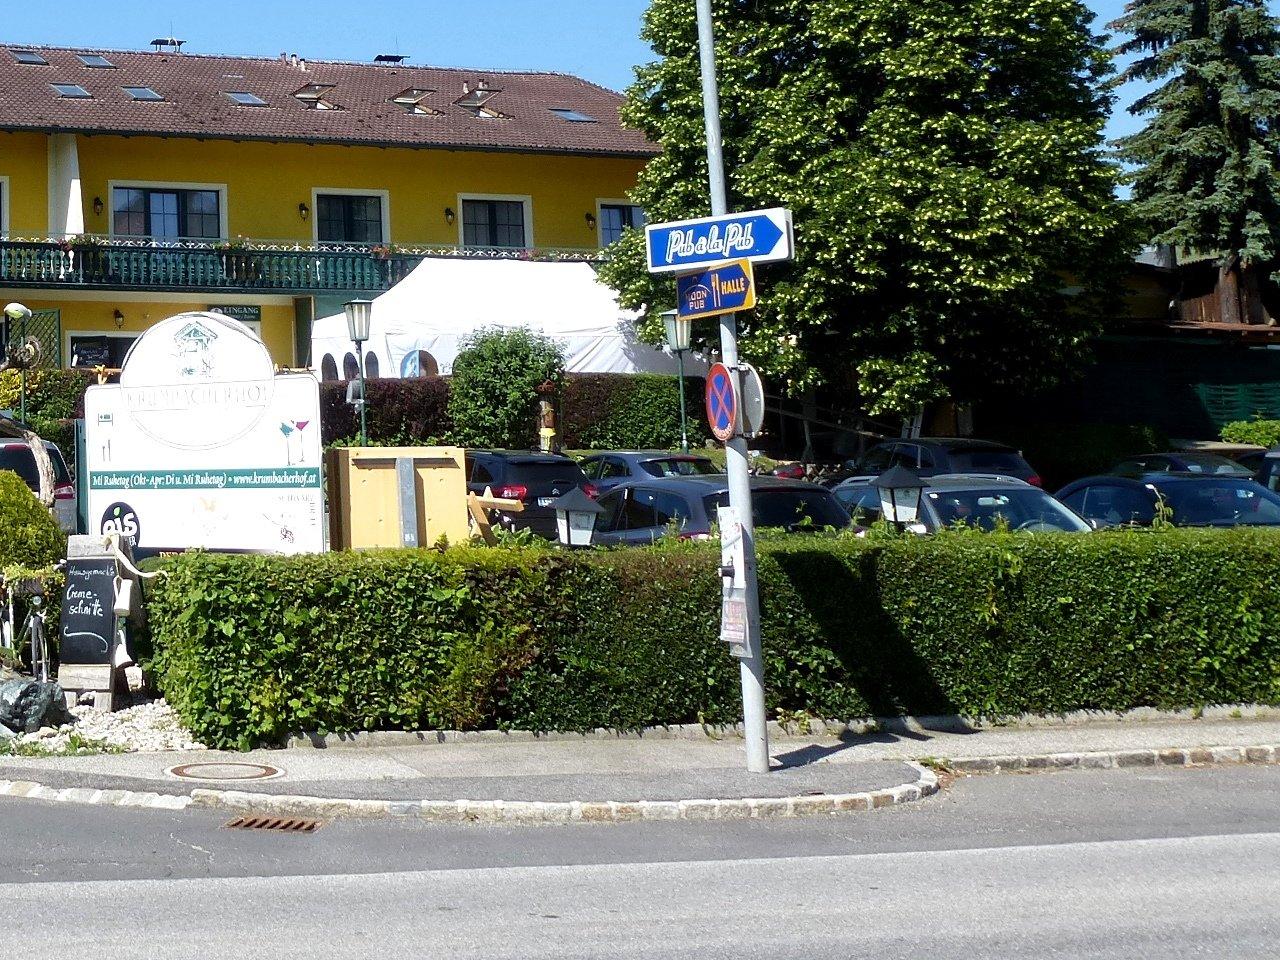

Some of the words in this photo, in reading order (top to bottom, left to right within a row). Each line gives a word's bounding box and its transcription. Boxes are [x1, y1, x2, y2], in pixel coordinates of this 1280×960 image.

[665, 229, 695, 263] Pub
[706, 225, 723, 253] la
[722, 222, 754, 257] Pub
[721, 277, 745, 295] HALLE
[689, 301, 705, 310] PUB
[92, 474, 103, 486] Mi
[103, 473, 130, 488] Ruhetag
[182, 473, 194, 485] Mi
[68, 598, 104, 617] schnitte
